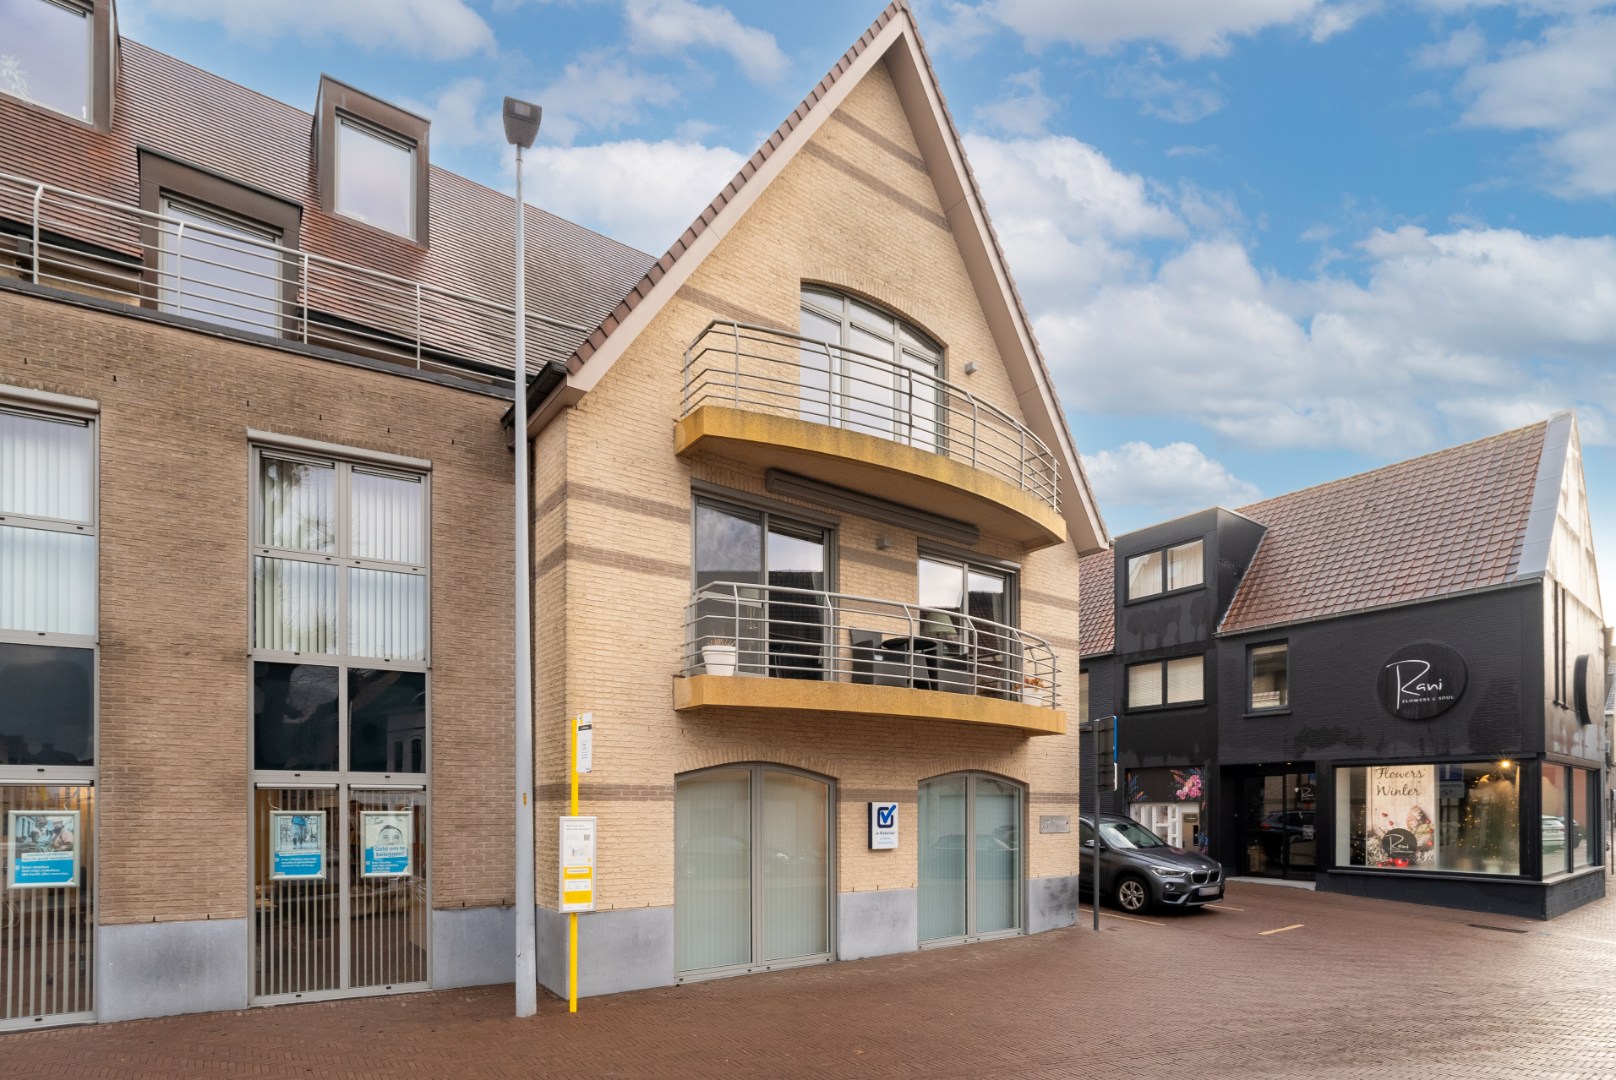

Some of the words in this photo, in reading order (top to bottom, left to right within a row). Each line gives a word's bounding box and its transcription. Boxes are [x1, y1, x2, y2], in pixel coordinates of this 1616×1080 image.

[1386, 660, 1443, 709] Rani
[1376, 767, 1425, 779] Flowers
[1377, 782, 1421, 796] Winter
